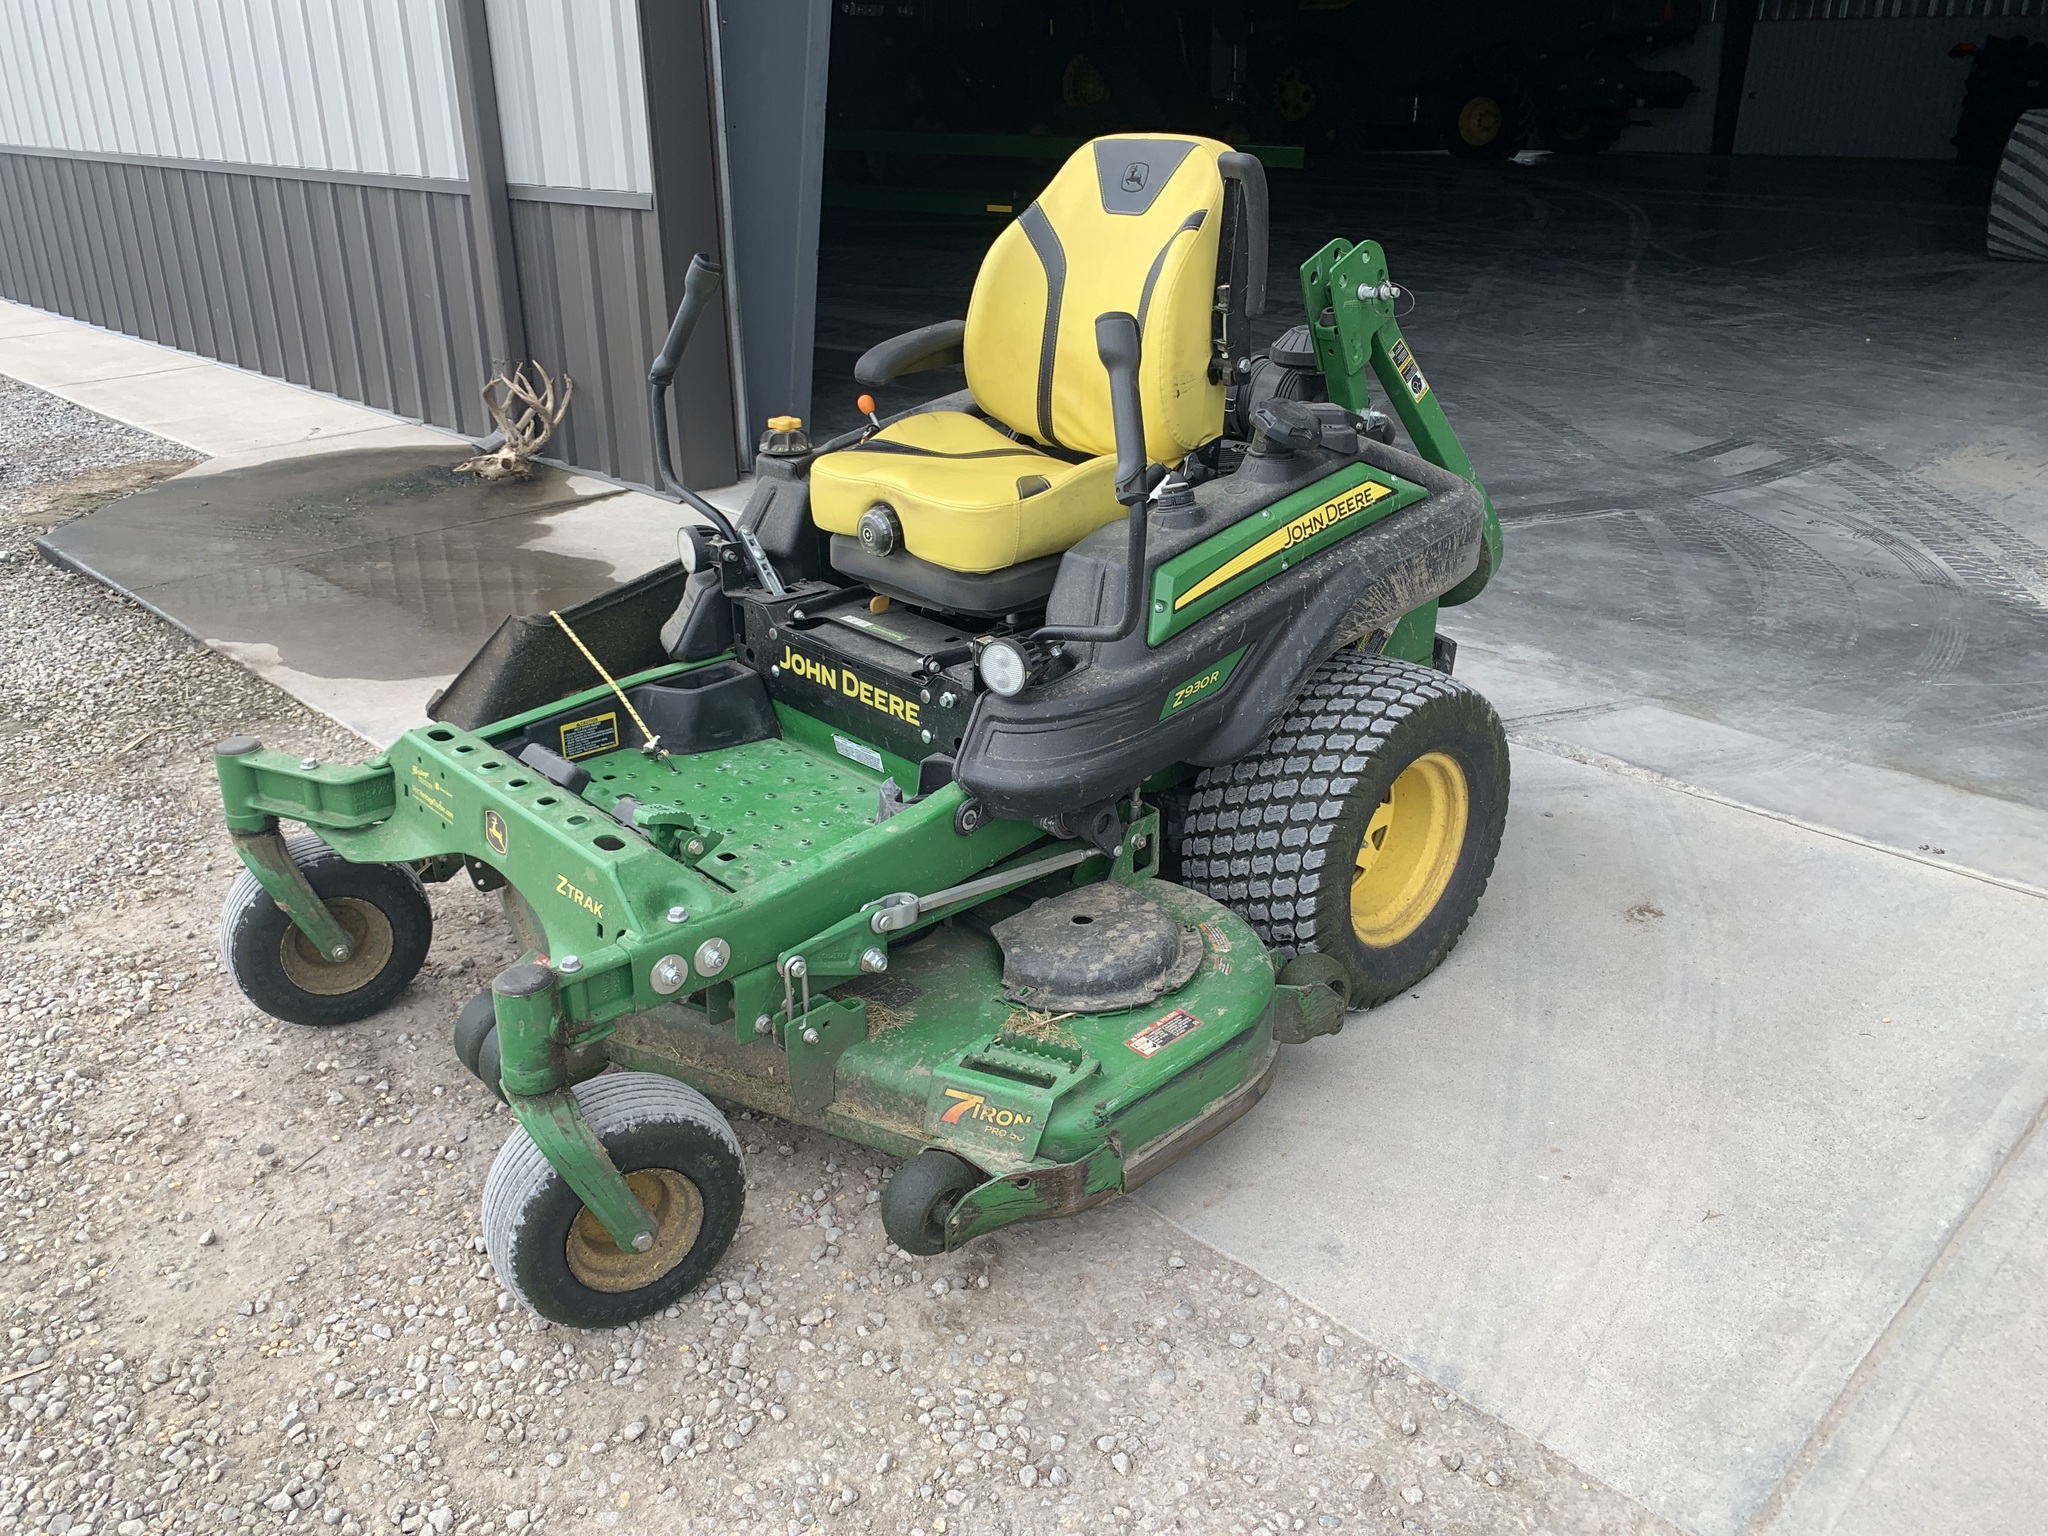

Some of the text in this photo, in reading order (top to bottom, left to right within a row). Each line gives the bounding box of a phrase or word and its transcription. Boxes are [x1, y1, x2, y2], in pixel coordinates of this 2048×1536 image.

[1284, 487, 1374, 547] JOHN DEERE
[780, 645, 920, 727] JOHN DEERE
[1172, 670, 1220, 709] Z930R
[556, 873, 604, 919] ZTRAK
[984, 1125, 1007, 1137] PRO
